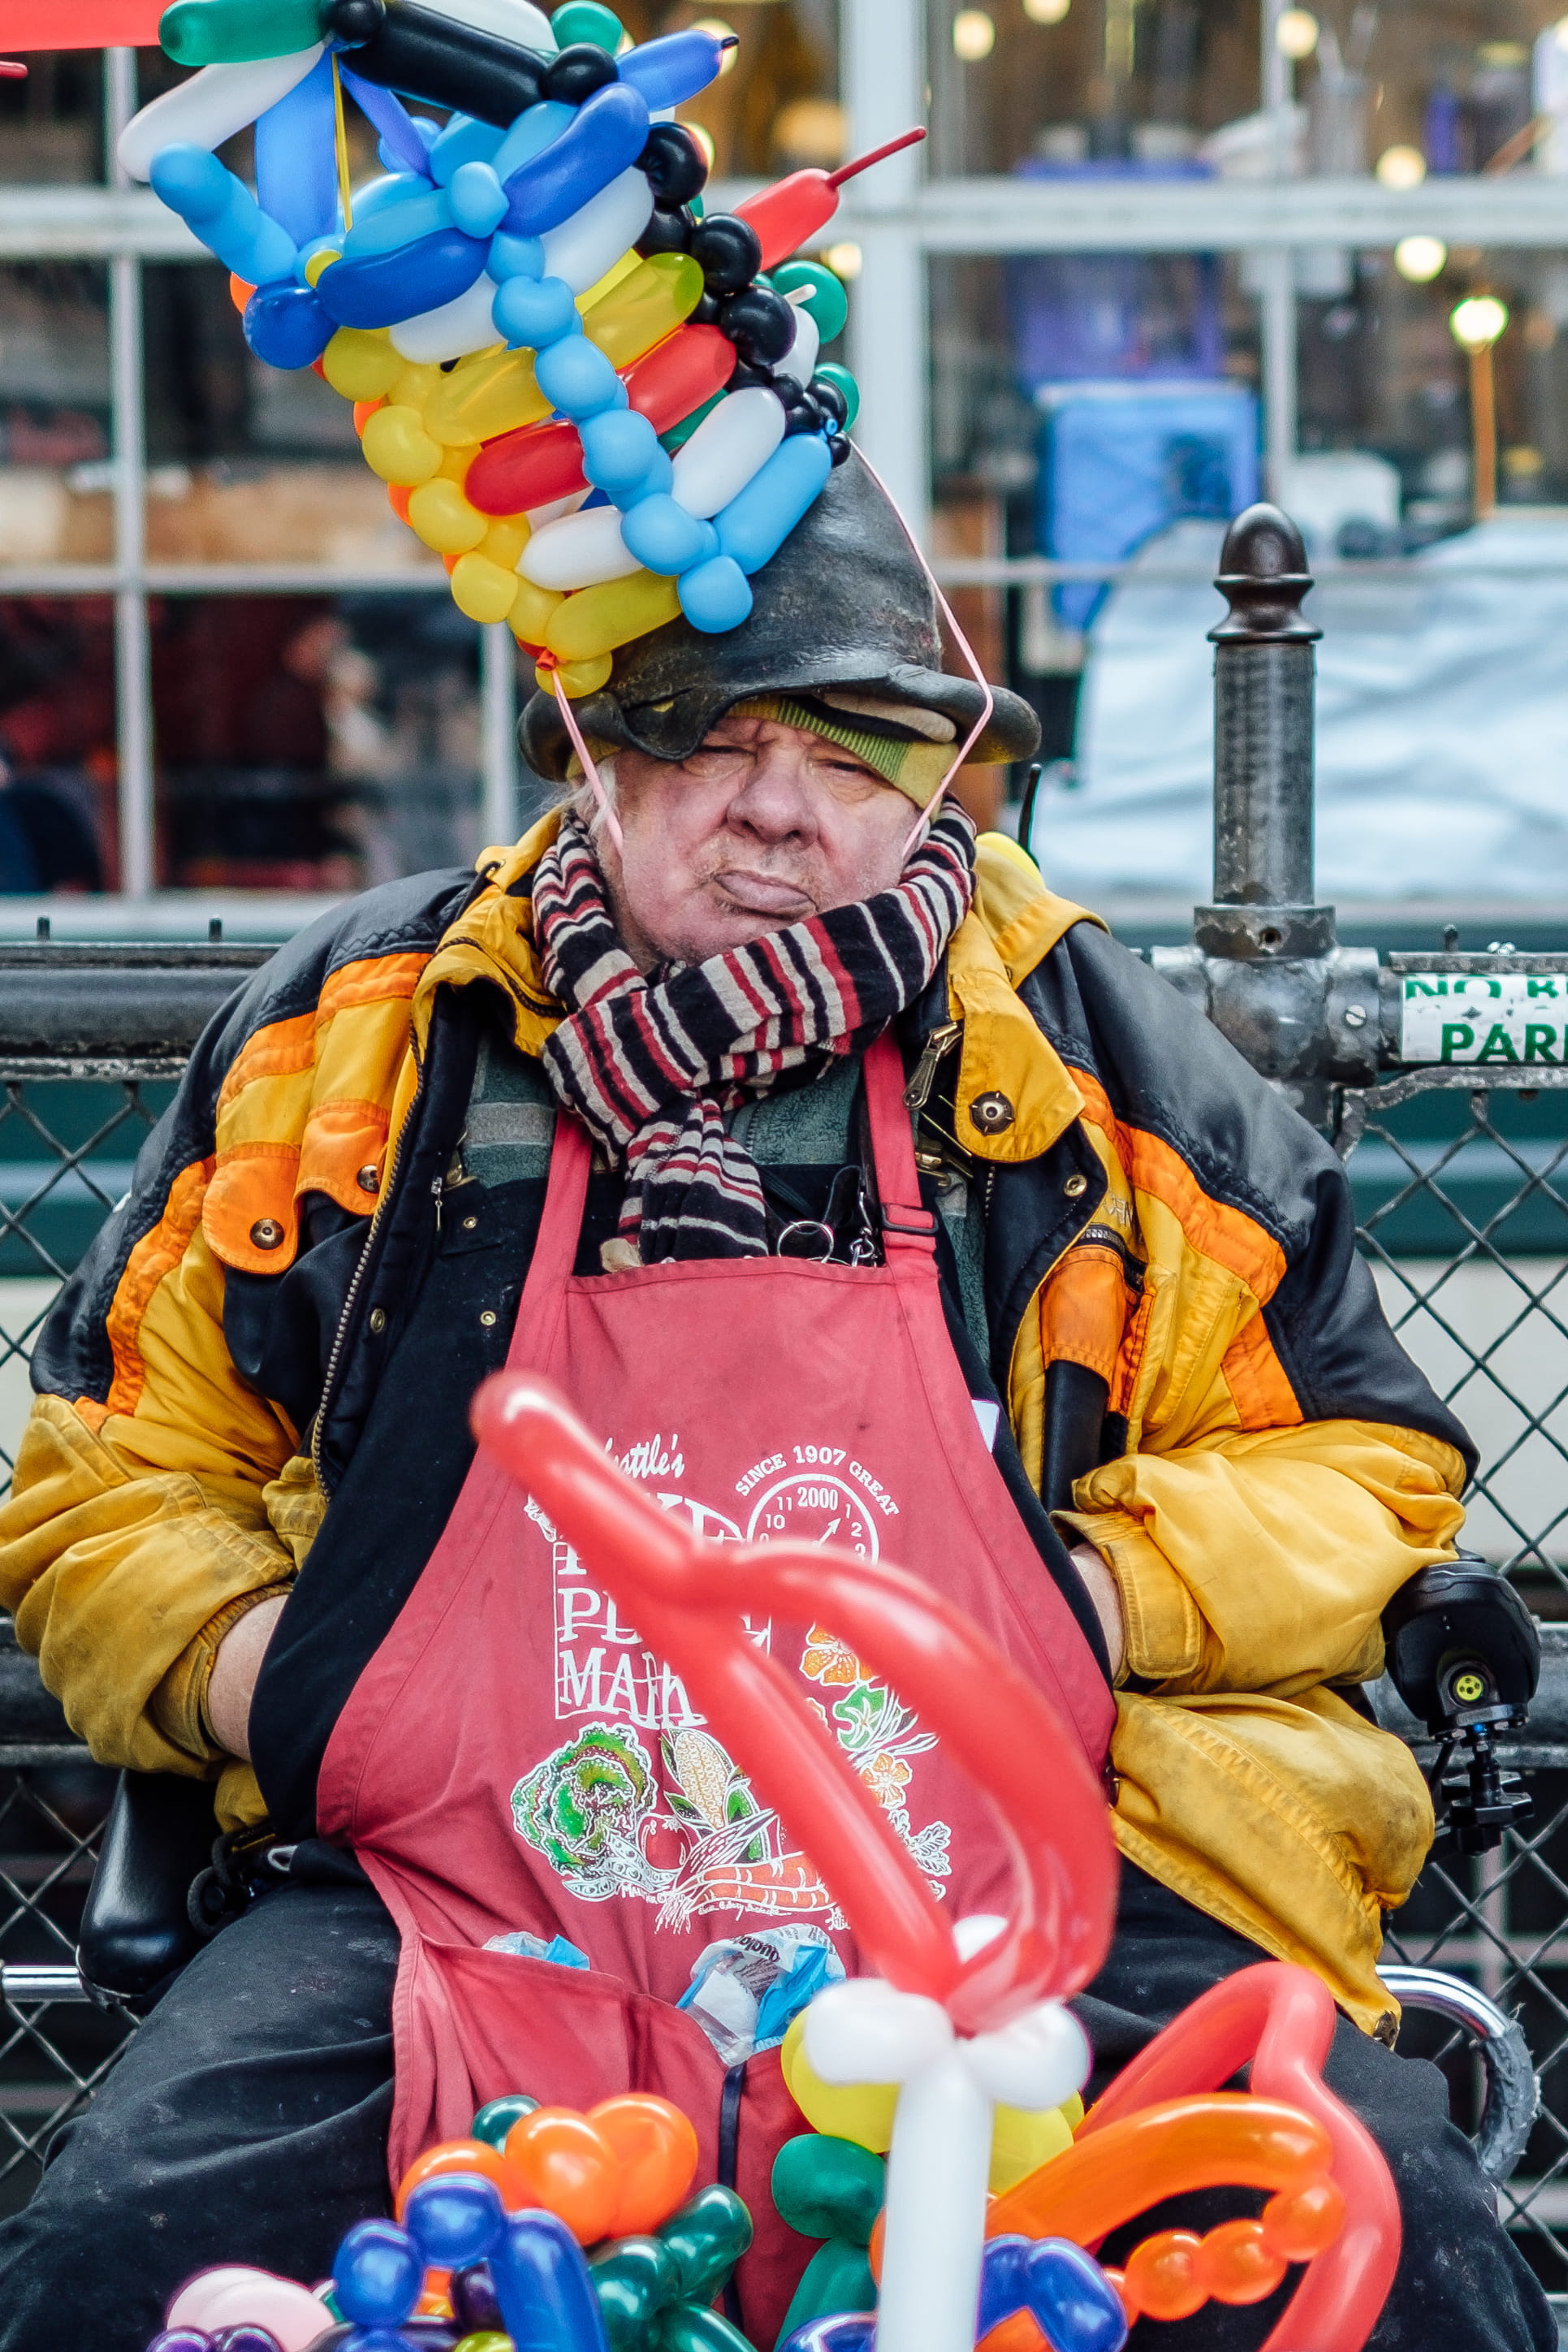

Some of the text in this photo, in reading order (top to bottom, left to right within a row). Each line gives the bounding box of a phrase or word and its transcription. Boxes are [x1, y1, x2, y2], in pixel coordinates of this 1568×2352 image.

[1441, 1023, 1568, 1062] PAR
[735, 1445, 900, 1515] SINCE 1907 GREAT
[776, 1496, 793, 1511] 11
[797, 1486, 839, 1511] 2000
[845, 1503, 851, 1519] 1
[766, 1513, 786, 1529] 10
[851, 1521, 862, 1537] 2
